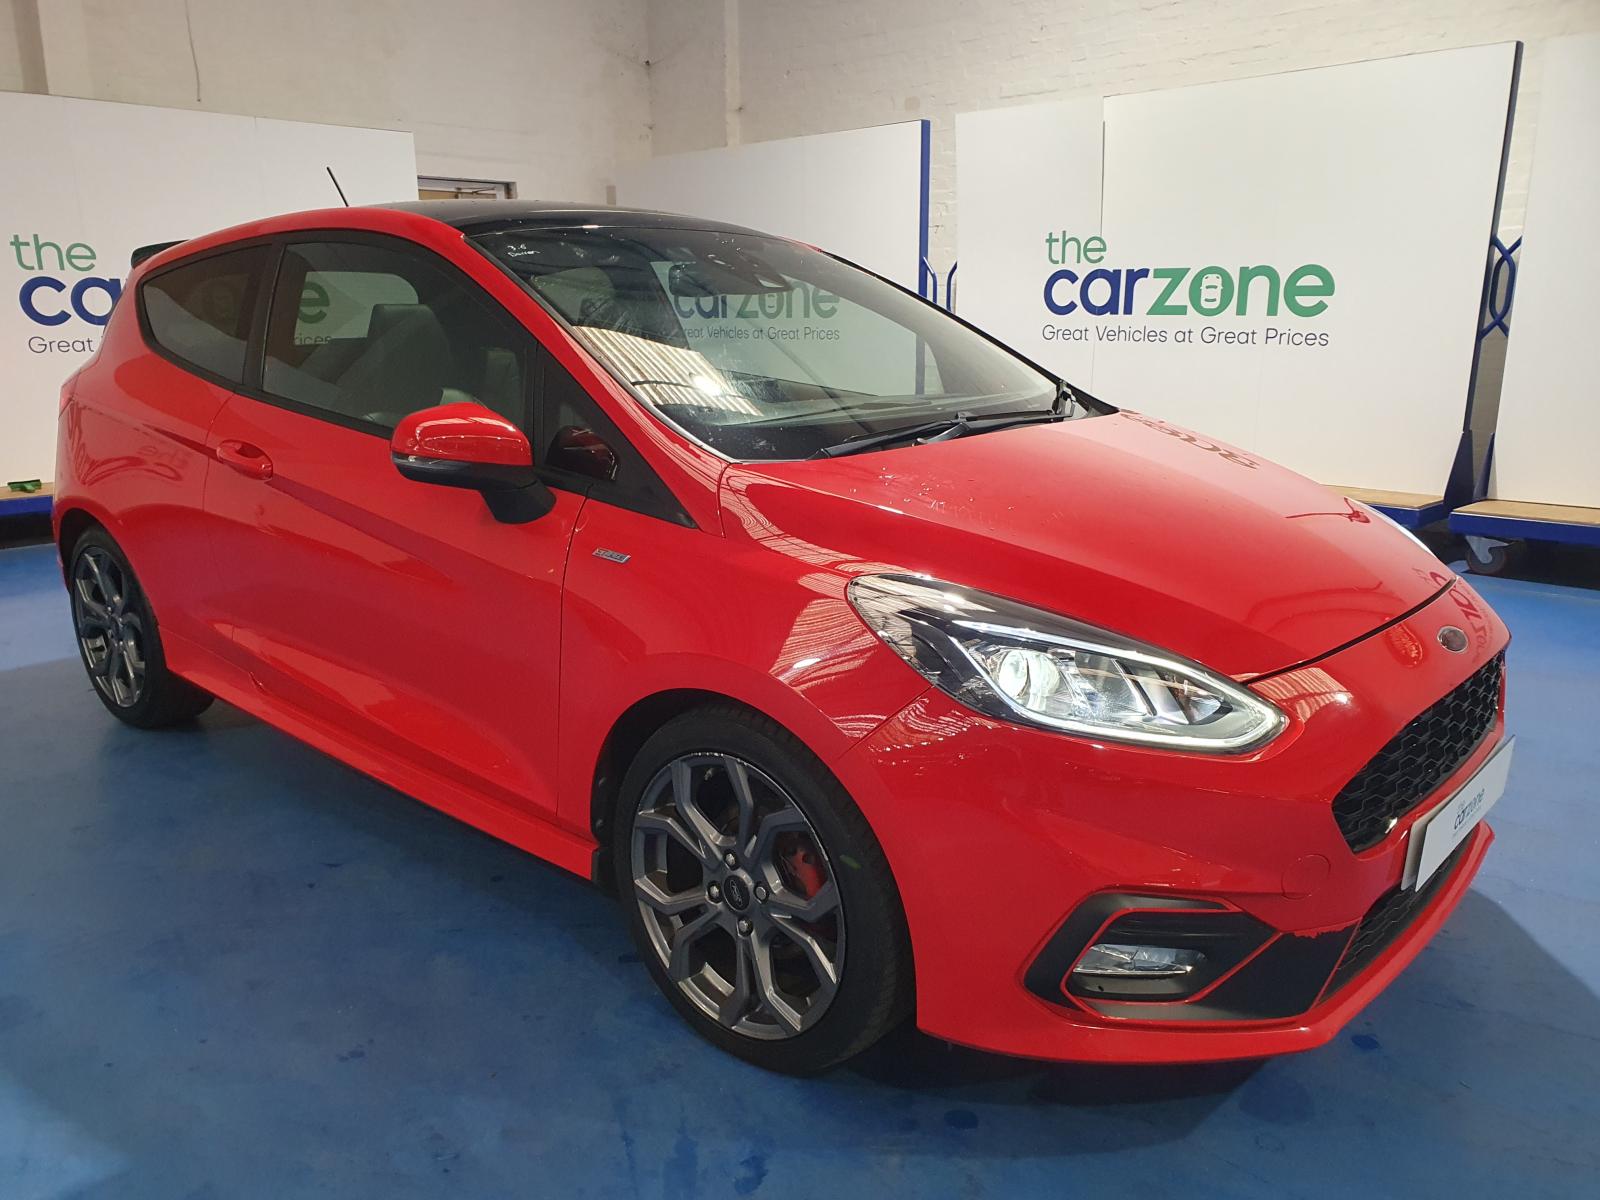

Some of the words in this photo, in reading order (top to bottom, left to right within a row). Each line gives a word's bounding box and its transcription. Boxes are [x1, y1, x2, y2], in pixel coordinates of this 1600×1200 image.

[10, 233, 97, 272] the
[1045, 230, 1107, 265] the
[19, 276, 122, 327] ca
[1043, 264, 1336, 318] carzone
[28, 336, 95, 354] Great
[686, 328, 704, 339] reat
[707, 326, 750, 340] Vehicles
[752, 328, 764, 340] at
[767, 326, 800, 341] Great
[804, 326, 840, 341] Prices
[1042, 324, 1089, 342] Great
[1096, 325, 1168, 343] Vehicles
[1174, 328, 1193, 344] at
[1200, 326, 1257, 345] Great
[1265, 327, 1330, 347] Prices
